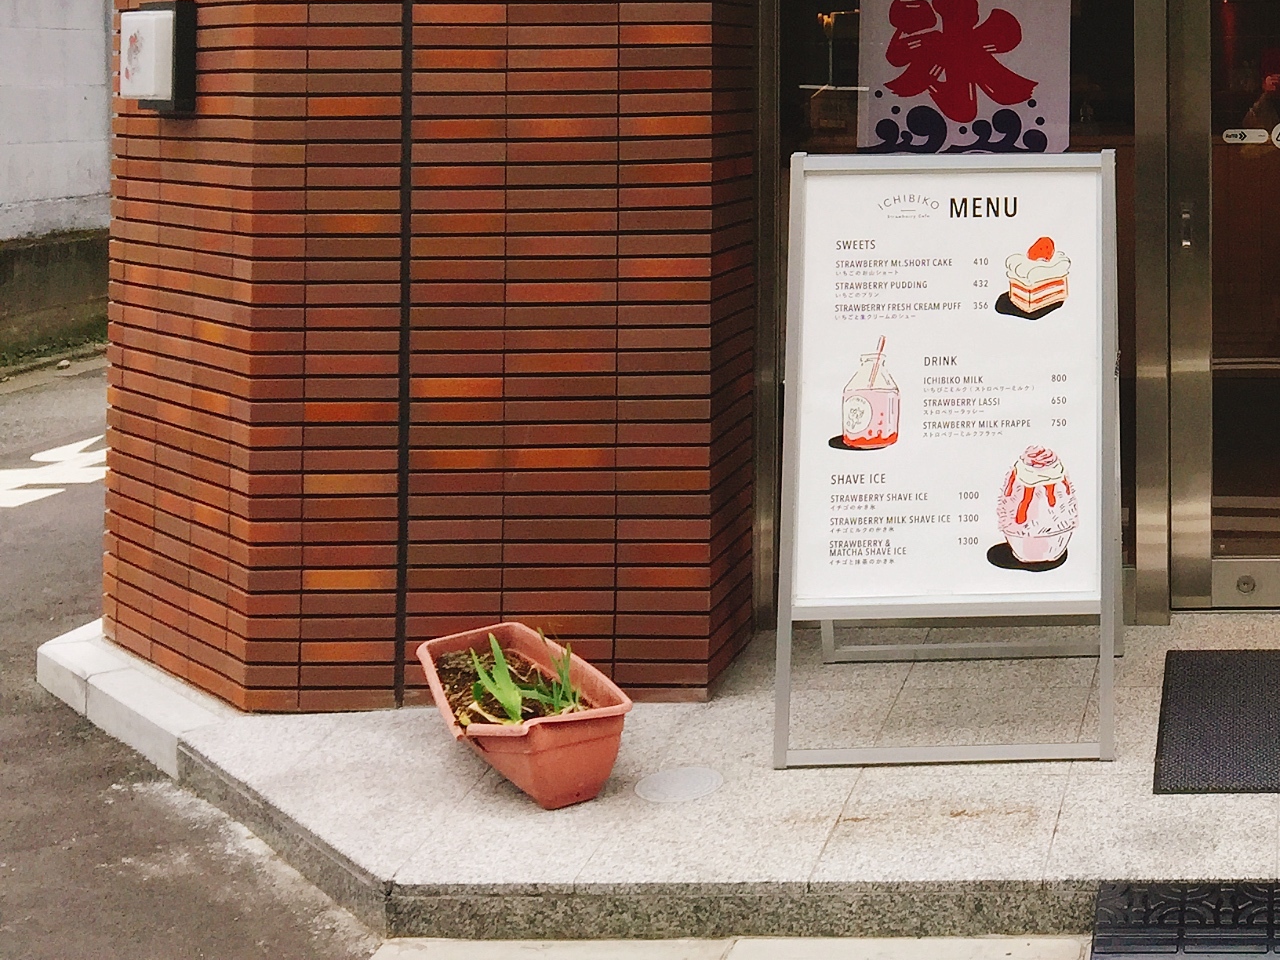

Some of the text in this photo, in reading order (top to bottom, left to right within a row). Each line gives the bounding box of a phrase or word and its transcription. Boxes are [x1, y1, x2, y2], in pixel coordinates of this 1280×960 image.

[877, 193, 1018, 219] ICHIBIKO MENU
[835, 240, 876, 251] SWEETS
[835, 257, 989, 269] STRAWBERRY Mt.SHORT CAKE 410
[835, 279, 989, 290] STRAWBERRY PUDDING 432
[834, 301, 989, 313] STRAWBERRY FRESH CREAM PUFF 356
[924, 355, 958, 367] DRINK
[923, 373, 1067, 385] ICHIBIKO MILK 800
[923, 396, 1067, 408] STRAWBERRY LASSI 650
[922, 418, 1067, 430] STRAWBERRY MILK FRAPPE 750
[830, 472, 887, 485] SHAVE ICE
[830, 491, 980, 503] STRAWBERRY SHAVE ICE 1000
[829, 514, 979, 526] STRAWBERRY MILK SHAVE ICE 1300
[829, 537, 979, 549] STRAWBERRY & 1300
[829, 546, 907, 557] MATCHA SHAVE ICE
